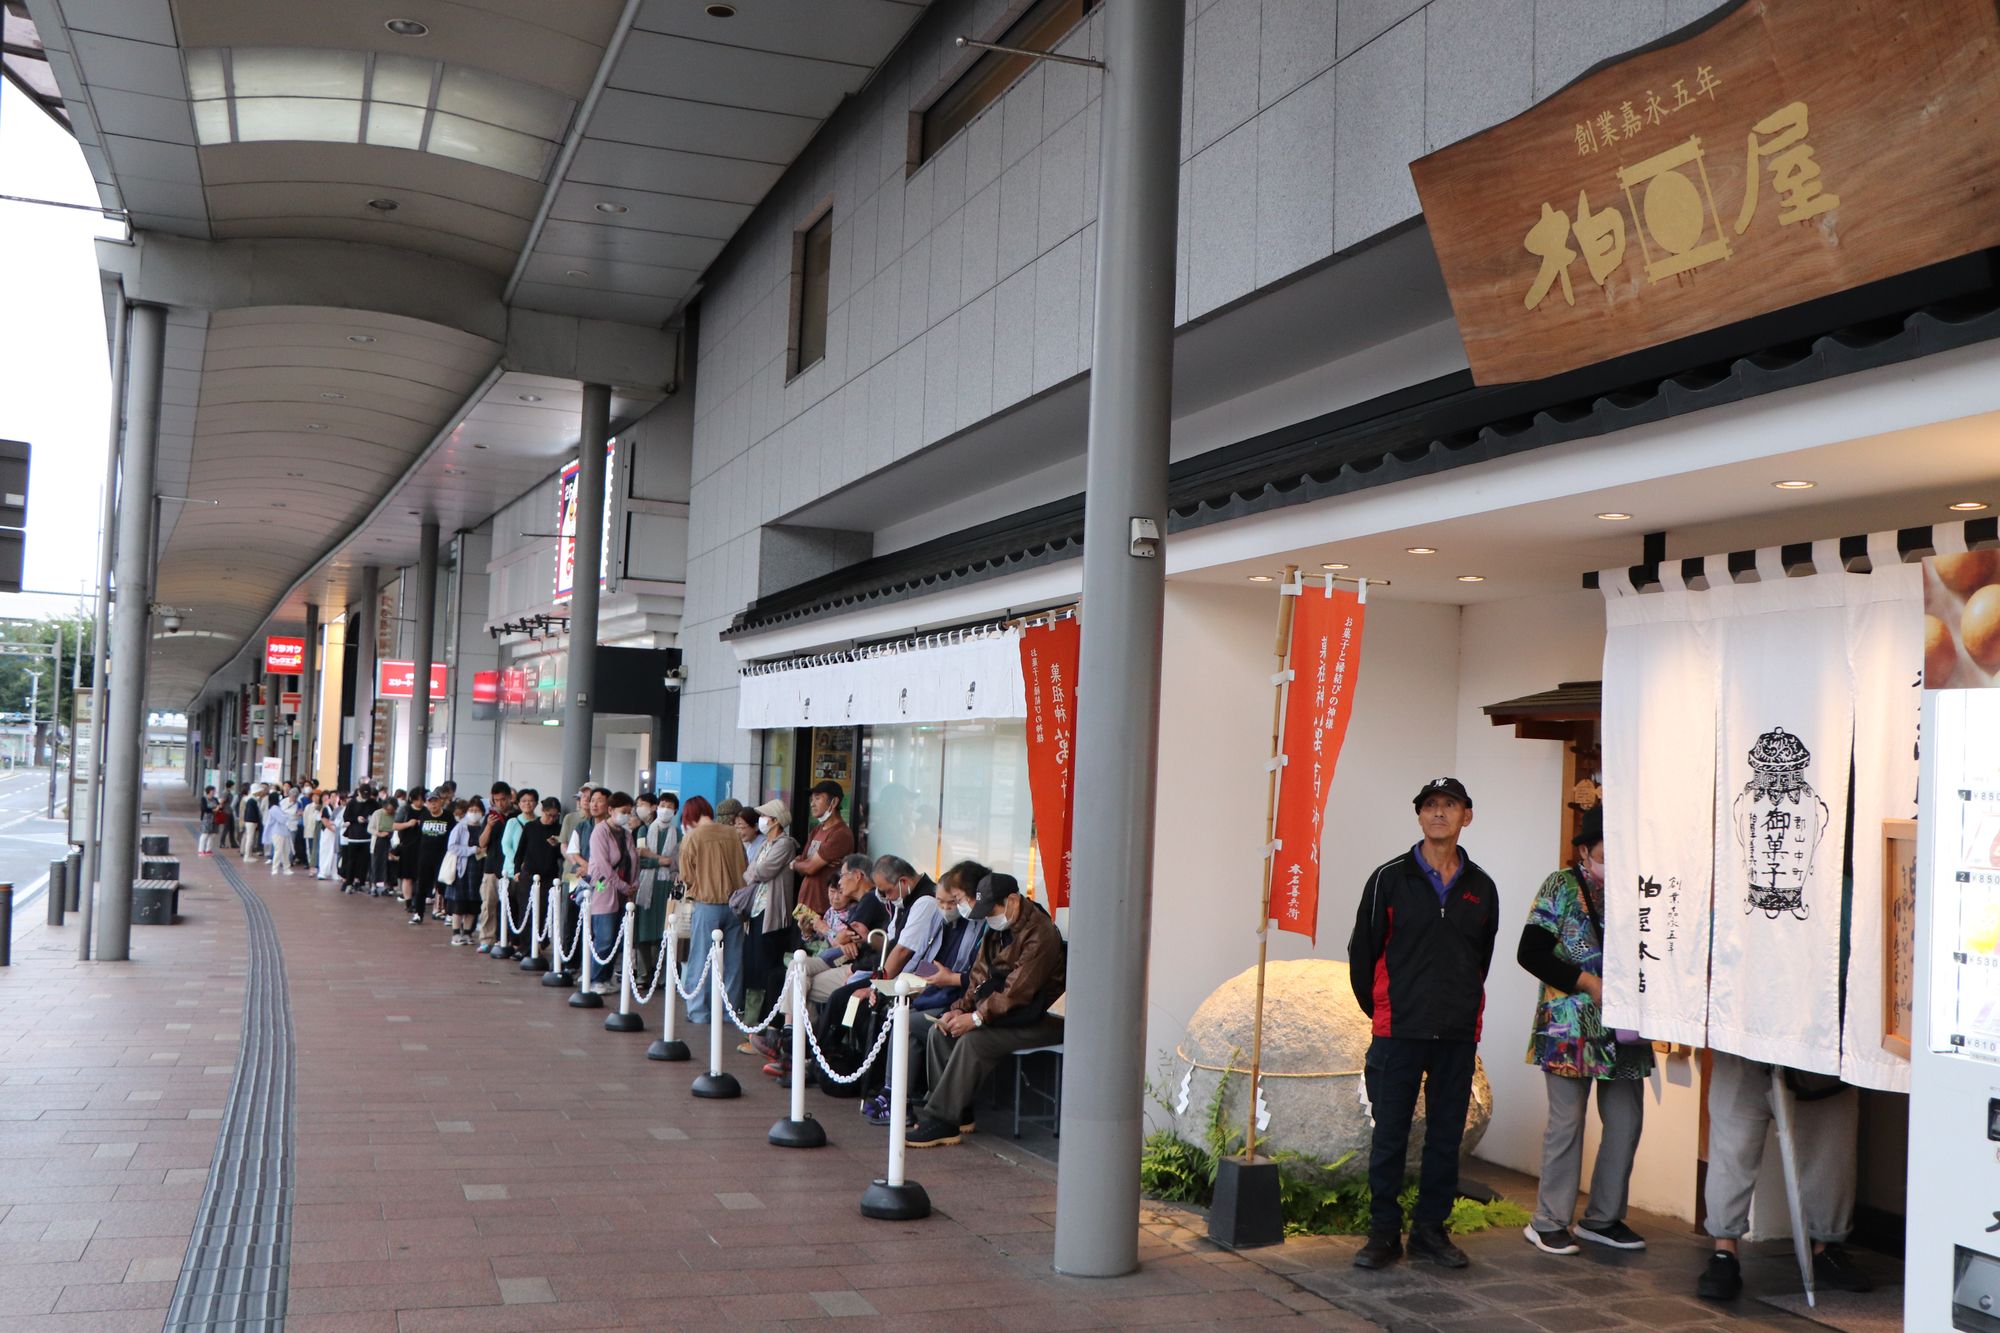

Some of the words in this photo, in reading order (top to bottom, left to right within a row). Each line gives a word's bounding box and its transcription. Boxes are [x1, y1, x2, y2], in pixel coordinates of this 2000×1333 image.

[1574, 66, 1722, 156] 創業嘉永五年
[1325, 616, 1353, 730] お菓子と縁結びの神様
[1760, 807, 1792, 889] 御菓子
[1792, 815, 1806, 882] 郡山中町
[1286, 863, 1304, 921] 本名善兵衛
